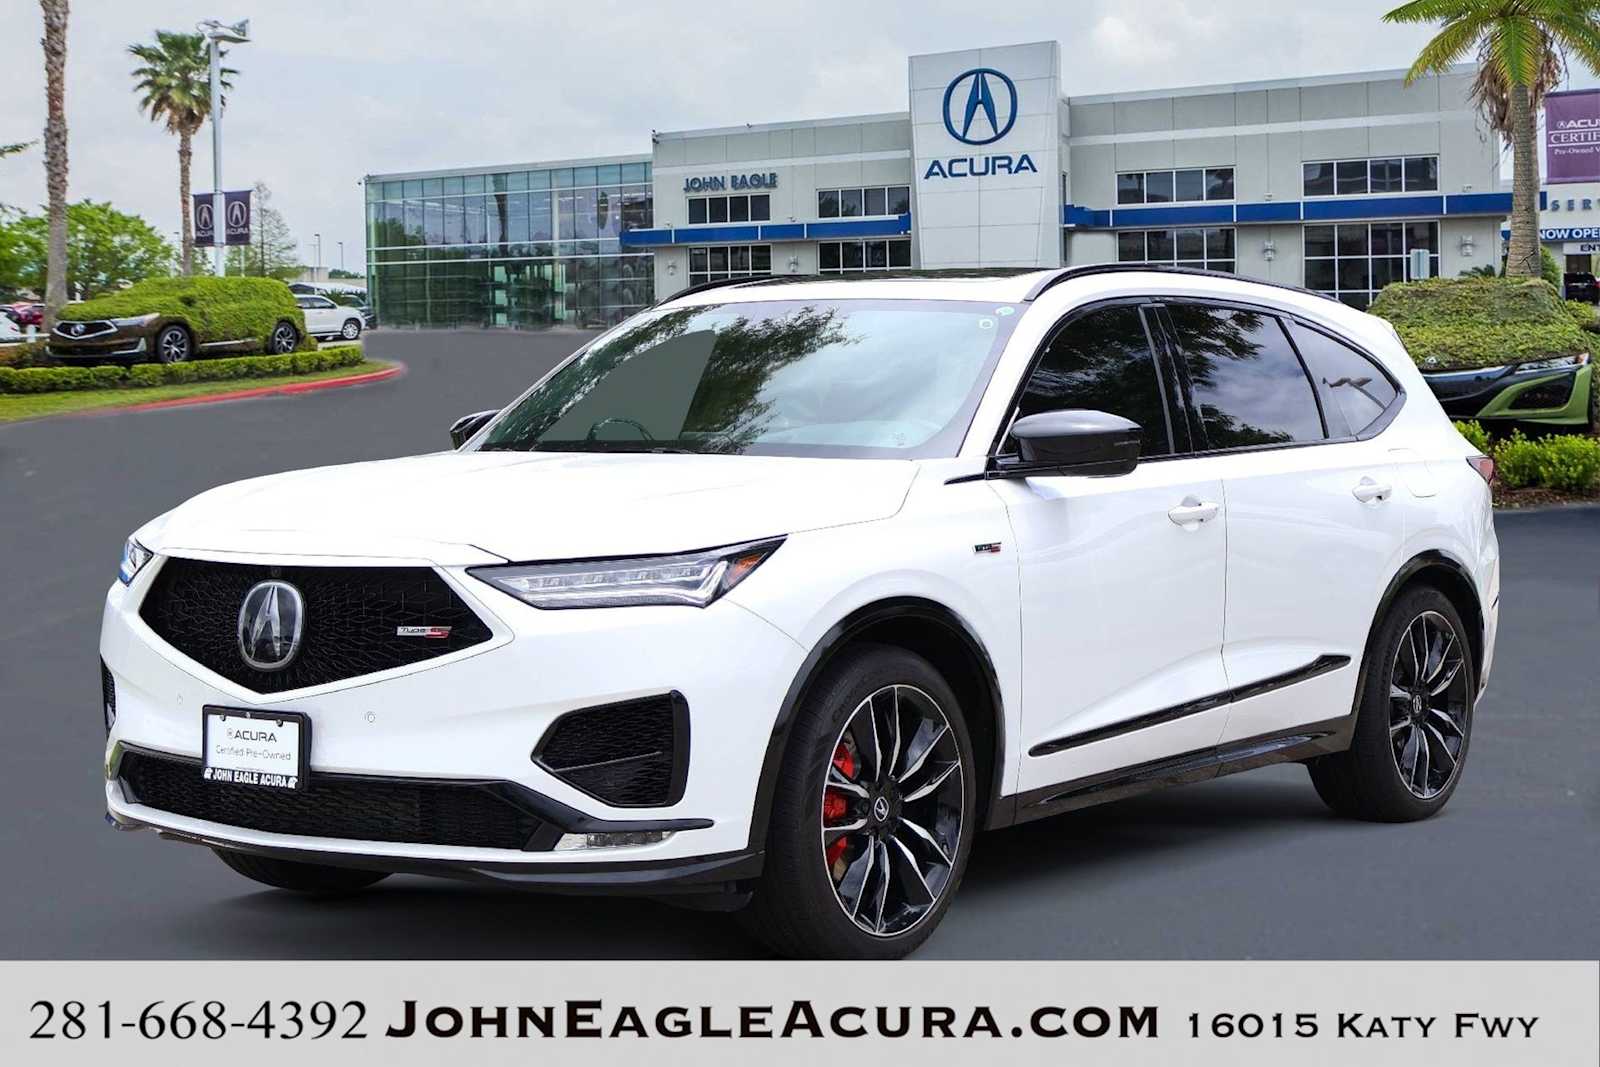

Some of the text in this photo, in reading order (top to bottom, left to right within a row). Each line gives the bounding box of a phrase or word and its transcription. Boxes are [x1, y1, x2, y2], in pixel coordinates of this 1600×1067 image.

[923, 153, 1038, 180] ACURA
[683, 172, 778, 192] JOHN EAGLE
[1572, 228, 1600, 239] OPE
[234, 729, 277, 743] ACURA
[246, 747, 292, 761] Pre-Owned
[213, 768, 233, 782] JOHN
[234, 771, 259, 785] EAGLE
[260, 774, 288, 788] ACURA
